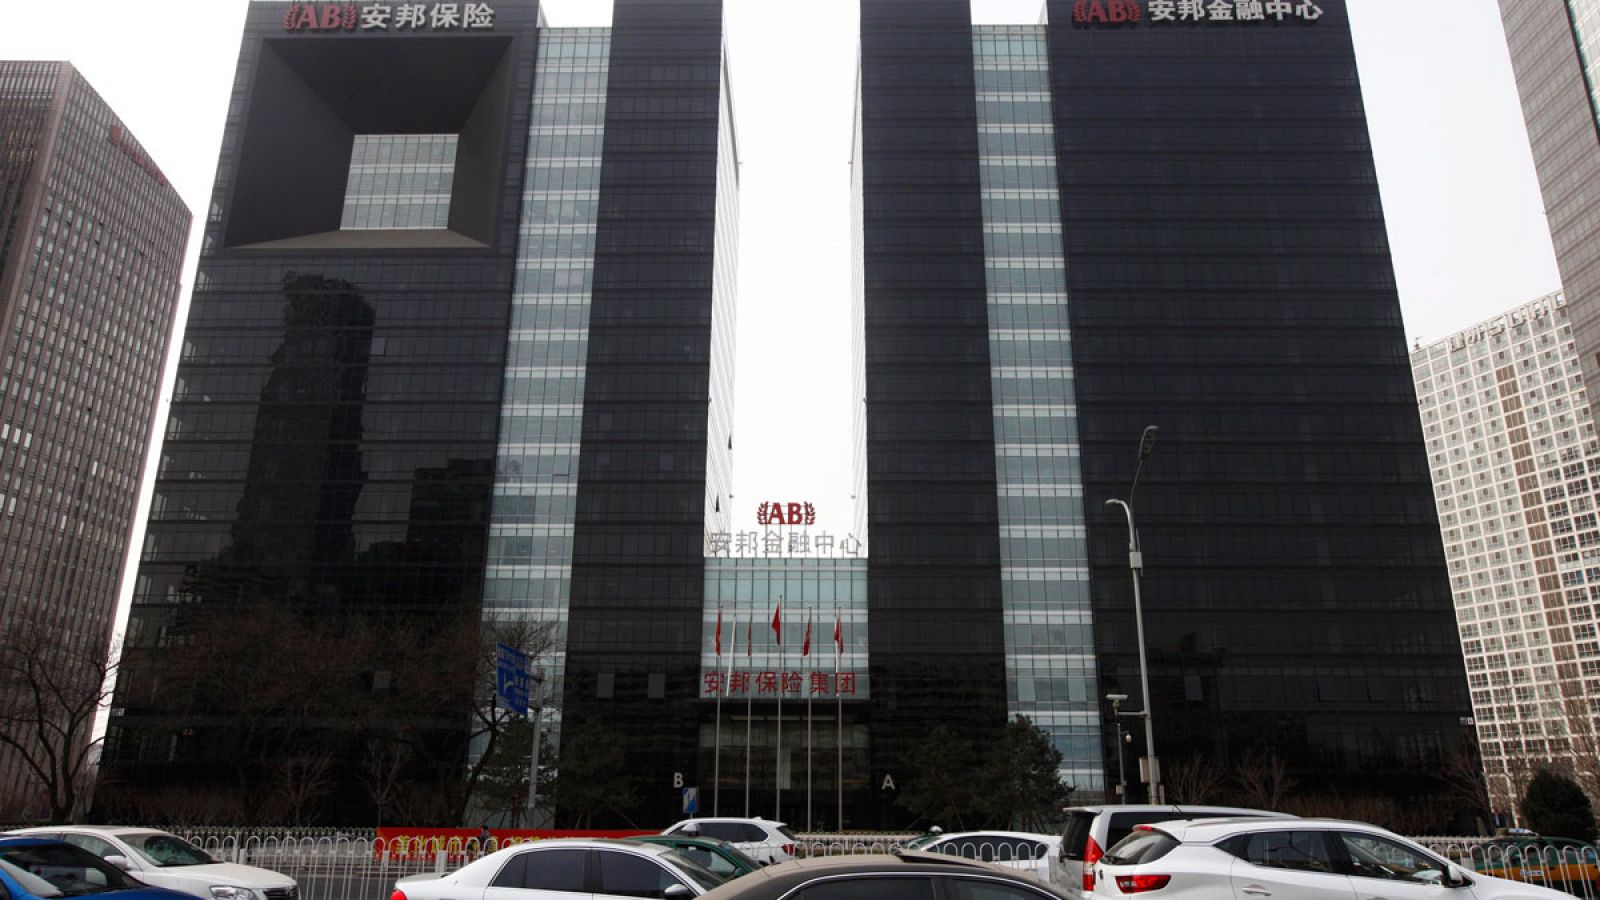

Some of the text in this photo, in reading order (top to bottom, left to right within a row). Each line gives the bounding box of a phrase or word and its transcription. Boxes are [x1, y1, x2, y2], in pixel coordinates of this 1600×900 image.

[296, 3, 343, 29] AB
[361, 3, 495, 29] 安邦保险
[1086, 0, 1129, 22] AB
[1148, 0, 1323, 21] 安邦金融中心
[767, 502, 804, 525] AB
[709, 530, 863, 555] 安邦金融中心
[703, 671, 856, 694] 安邦保险集团
[673, 772, 684, 788] B
[881, 774, 896, 790] A
